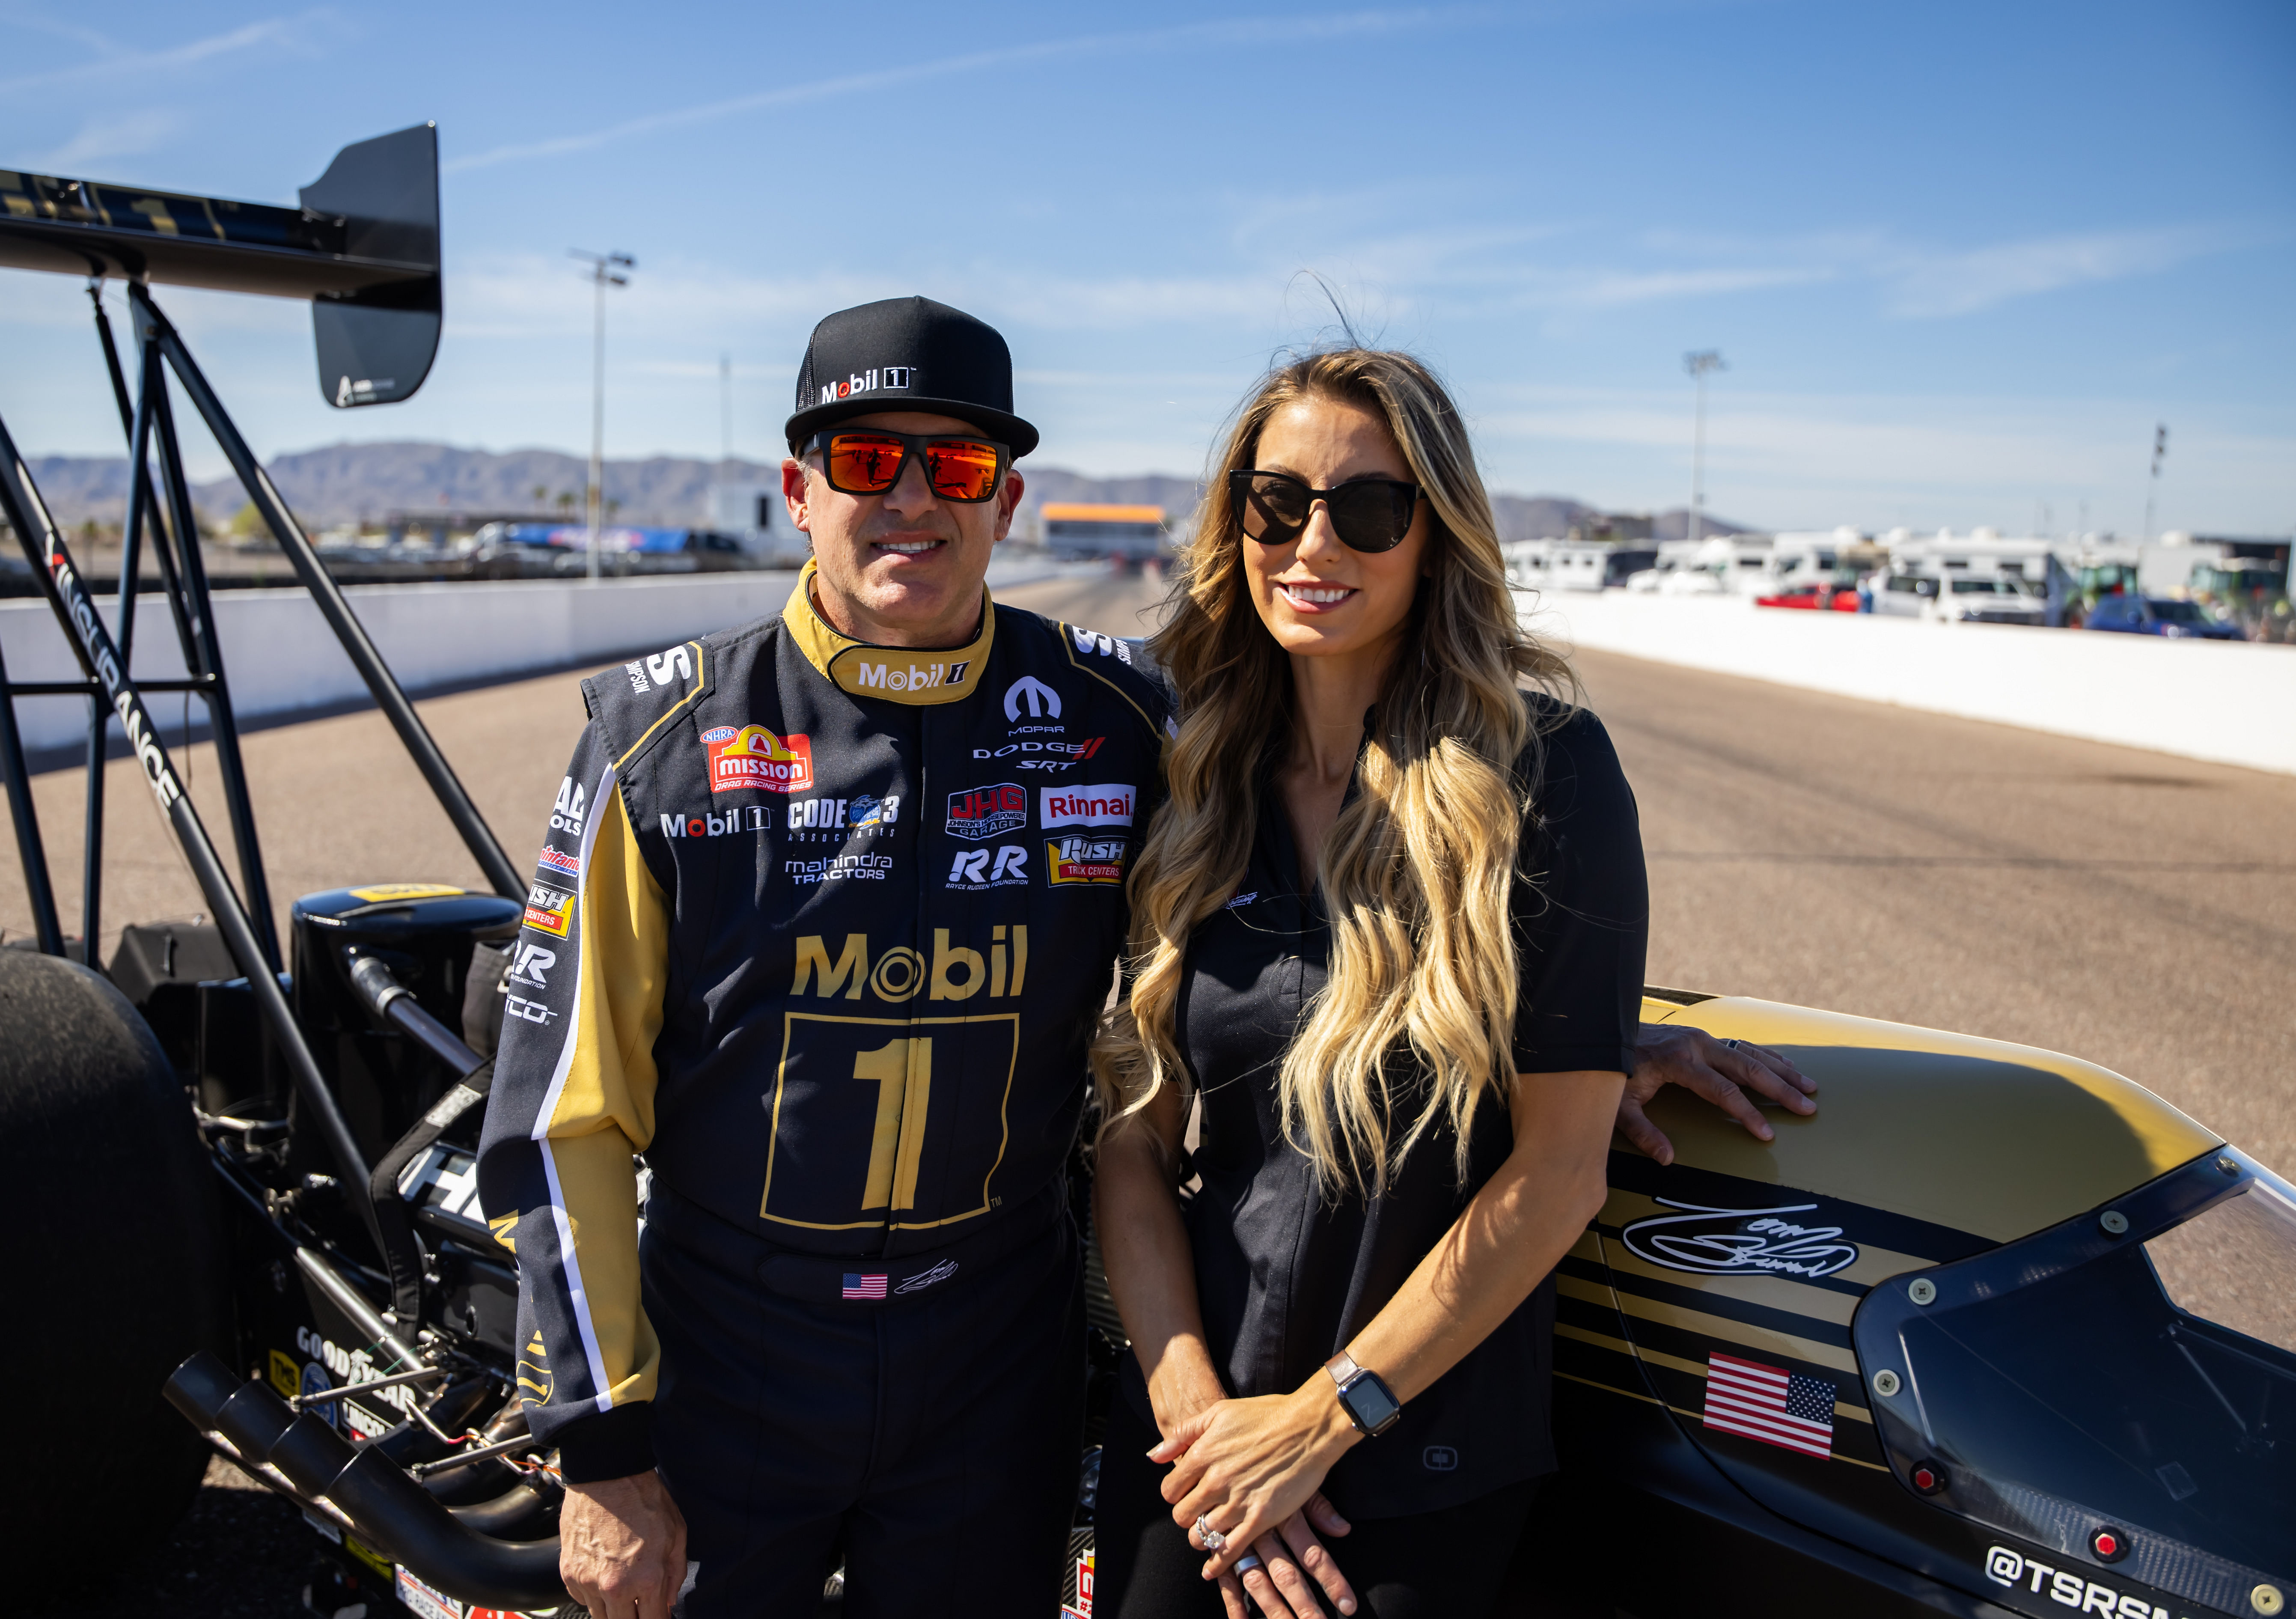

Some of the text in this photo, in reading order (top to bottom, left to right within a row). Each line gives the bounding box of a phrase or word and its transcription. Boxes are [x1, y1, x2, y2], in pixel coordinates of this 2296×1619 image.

[821, 369, 877, 404] Mobil
[624, 661, 651, 694] SIMPSON
[858, 662, 944, 691] Mobil
[706, 729, 733, 741] NHRA
[1008, 726, 1065, 737] MOPAR
[973, 742, 1086, 759] DODGE
[1016, 760, 1077, 773] SRT
[714, 780, 812, 792] DRAG RACING SERIES
[951, 786, 1024, 820] JHG
[1049, 794, 1130, 818] Rinnai
[787, 798, 847, 829] CODE
[883, 795, 899, 823] 3
[947, 812, 1025, 828] JOHNSON'S HORSEPOWERED
[660, 808, 740, 838] Mobil
[959, 820, 1016, 837] GARAGE
[788, 828, 895, 842] ASSOCIATES
[785, 851, 892, 873] mahindra
[792, 868, 885, 885] TRACTORS
[1088, 866, 1119, 876] CENTERS
[991, 879, 1029, 888] FOUNDATION
[527, 910, 556, 926] CENTERS
[790, 925, 1028, 1003] Mobil
[514, 975, 546, 990] FOUNDATION
[852, 1037, 933, 1211] 1
